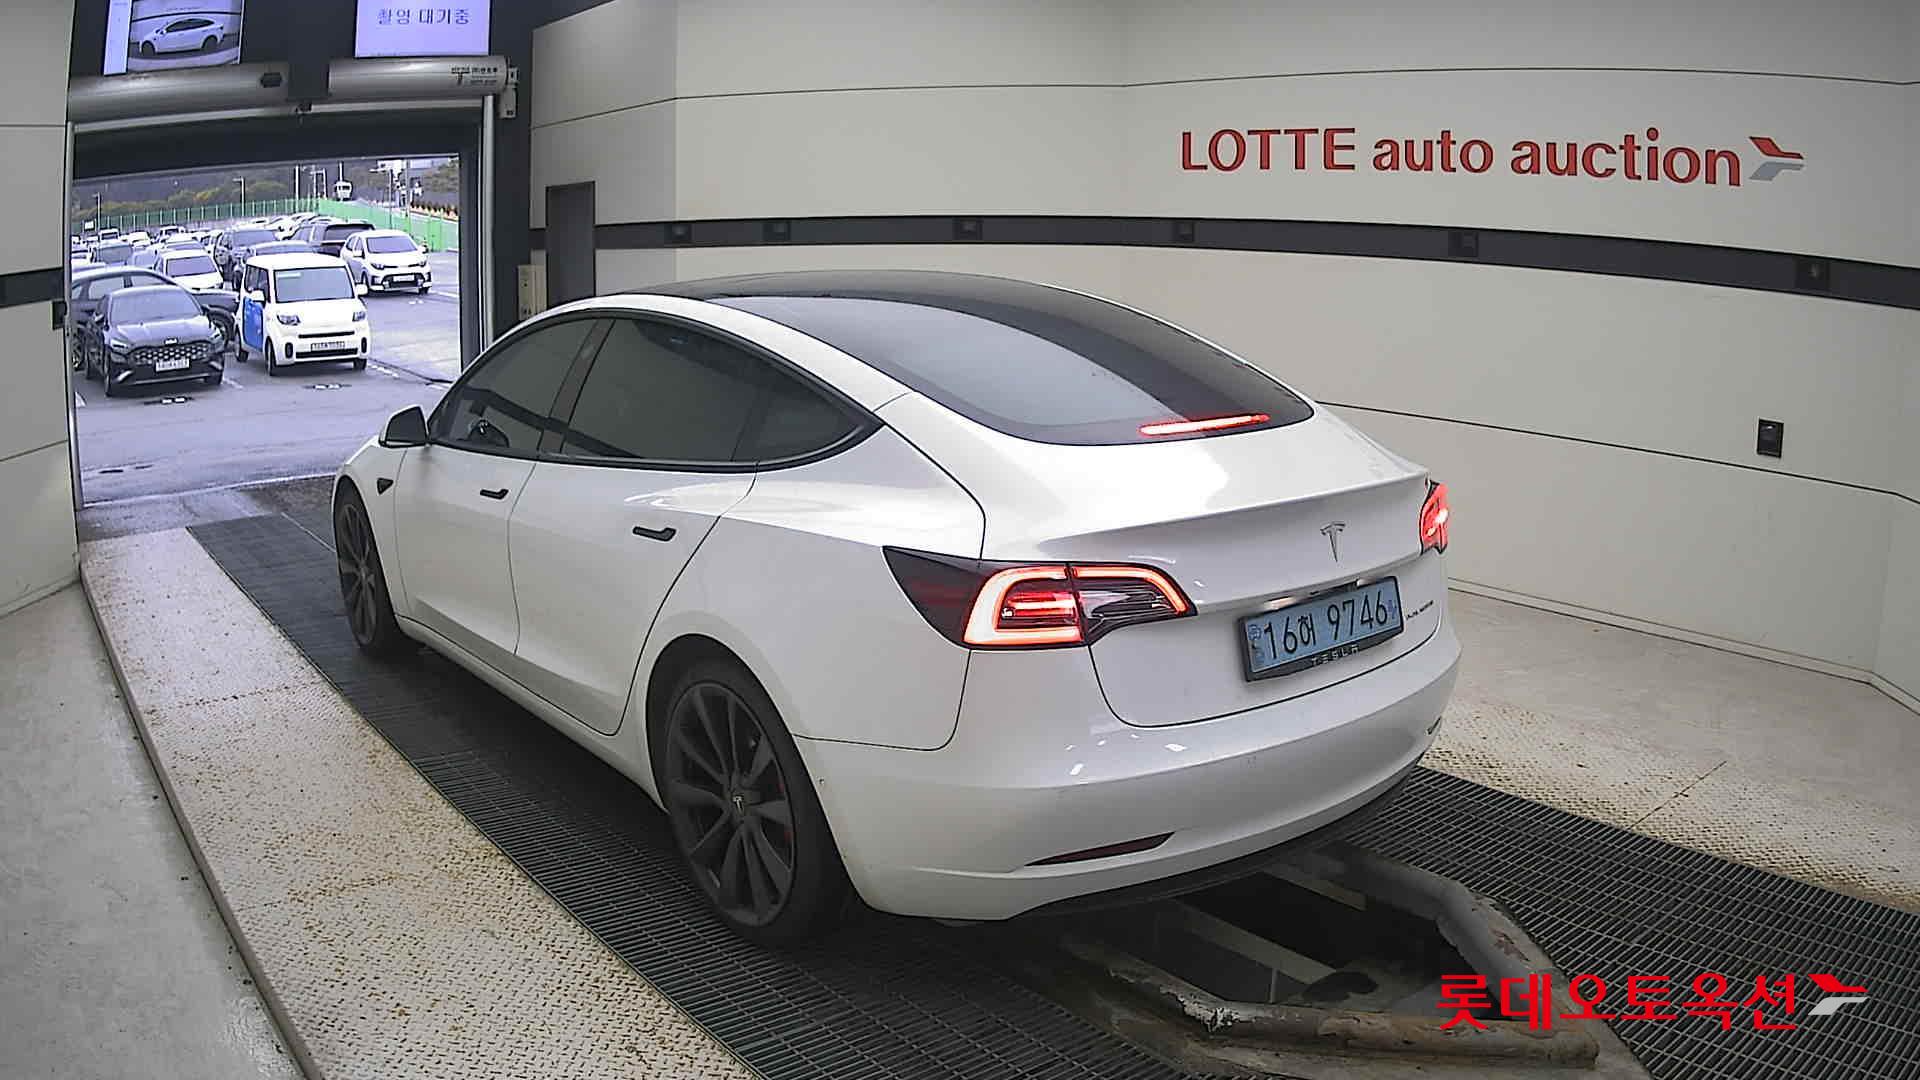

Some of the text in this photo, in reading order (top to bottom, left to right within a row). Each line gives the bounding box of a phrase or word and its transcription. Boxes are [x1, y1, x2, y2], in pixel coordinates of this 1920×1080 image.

[419, 7, 470, 25] 대기중
[1181, 127, 1742, 187] LOTTE auto auction
[1263, 612, 1317, 660] 16허
[1326, 590, 1388, 641] 9746
[1311, 643, 1360, 667] TESLA
